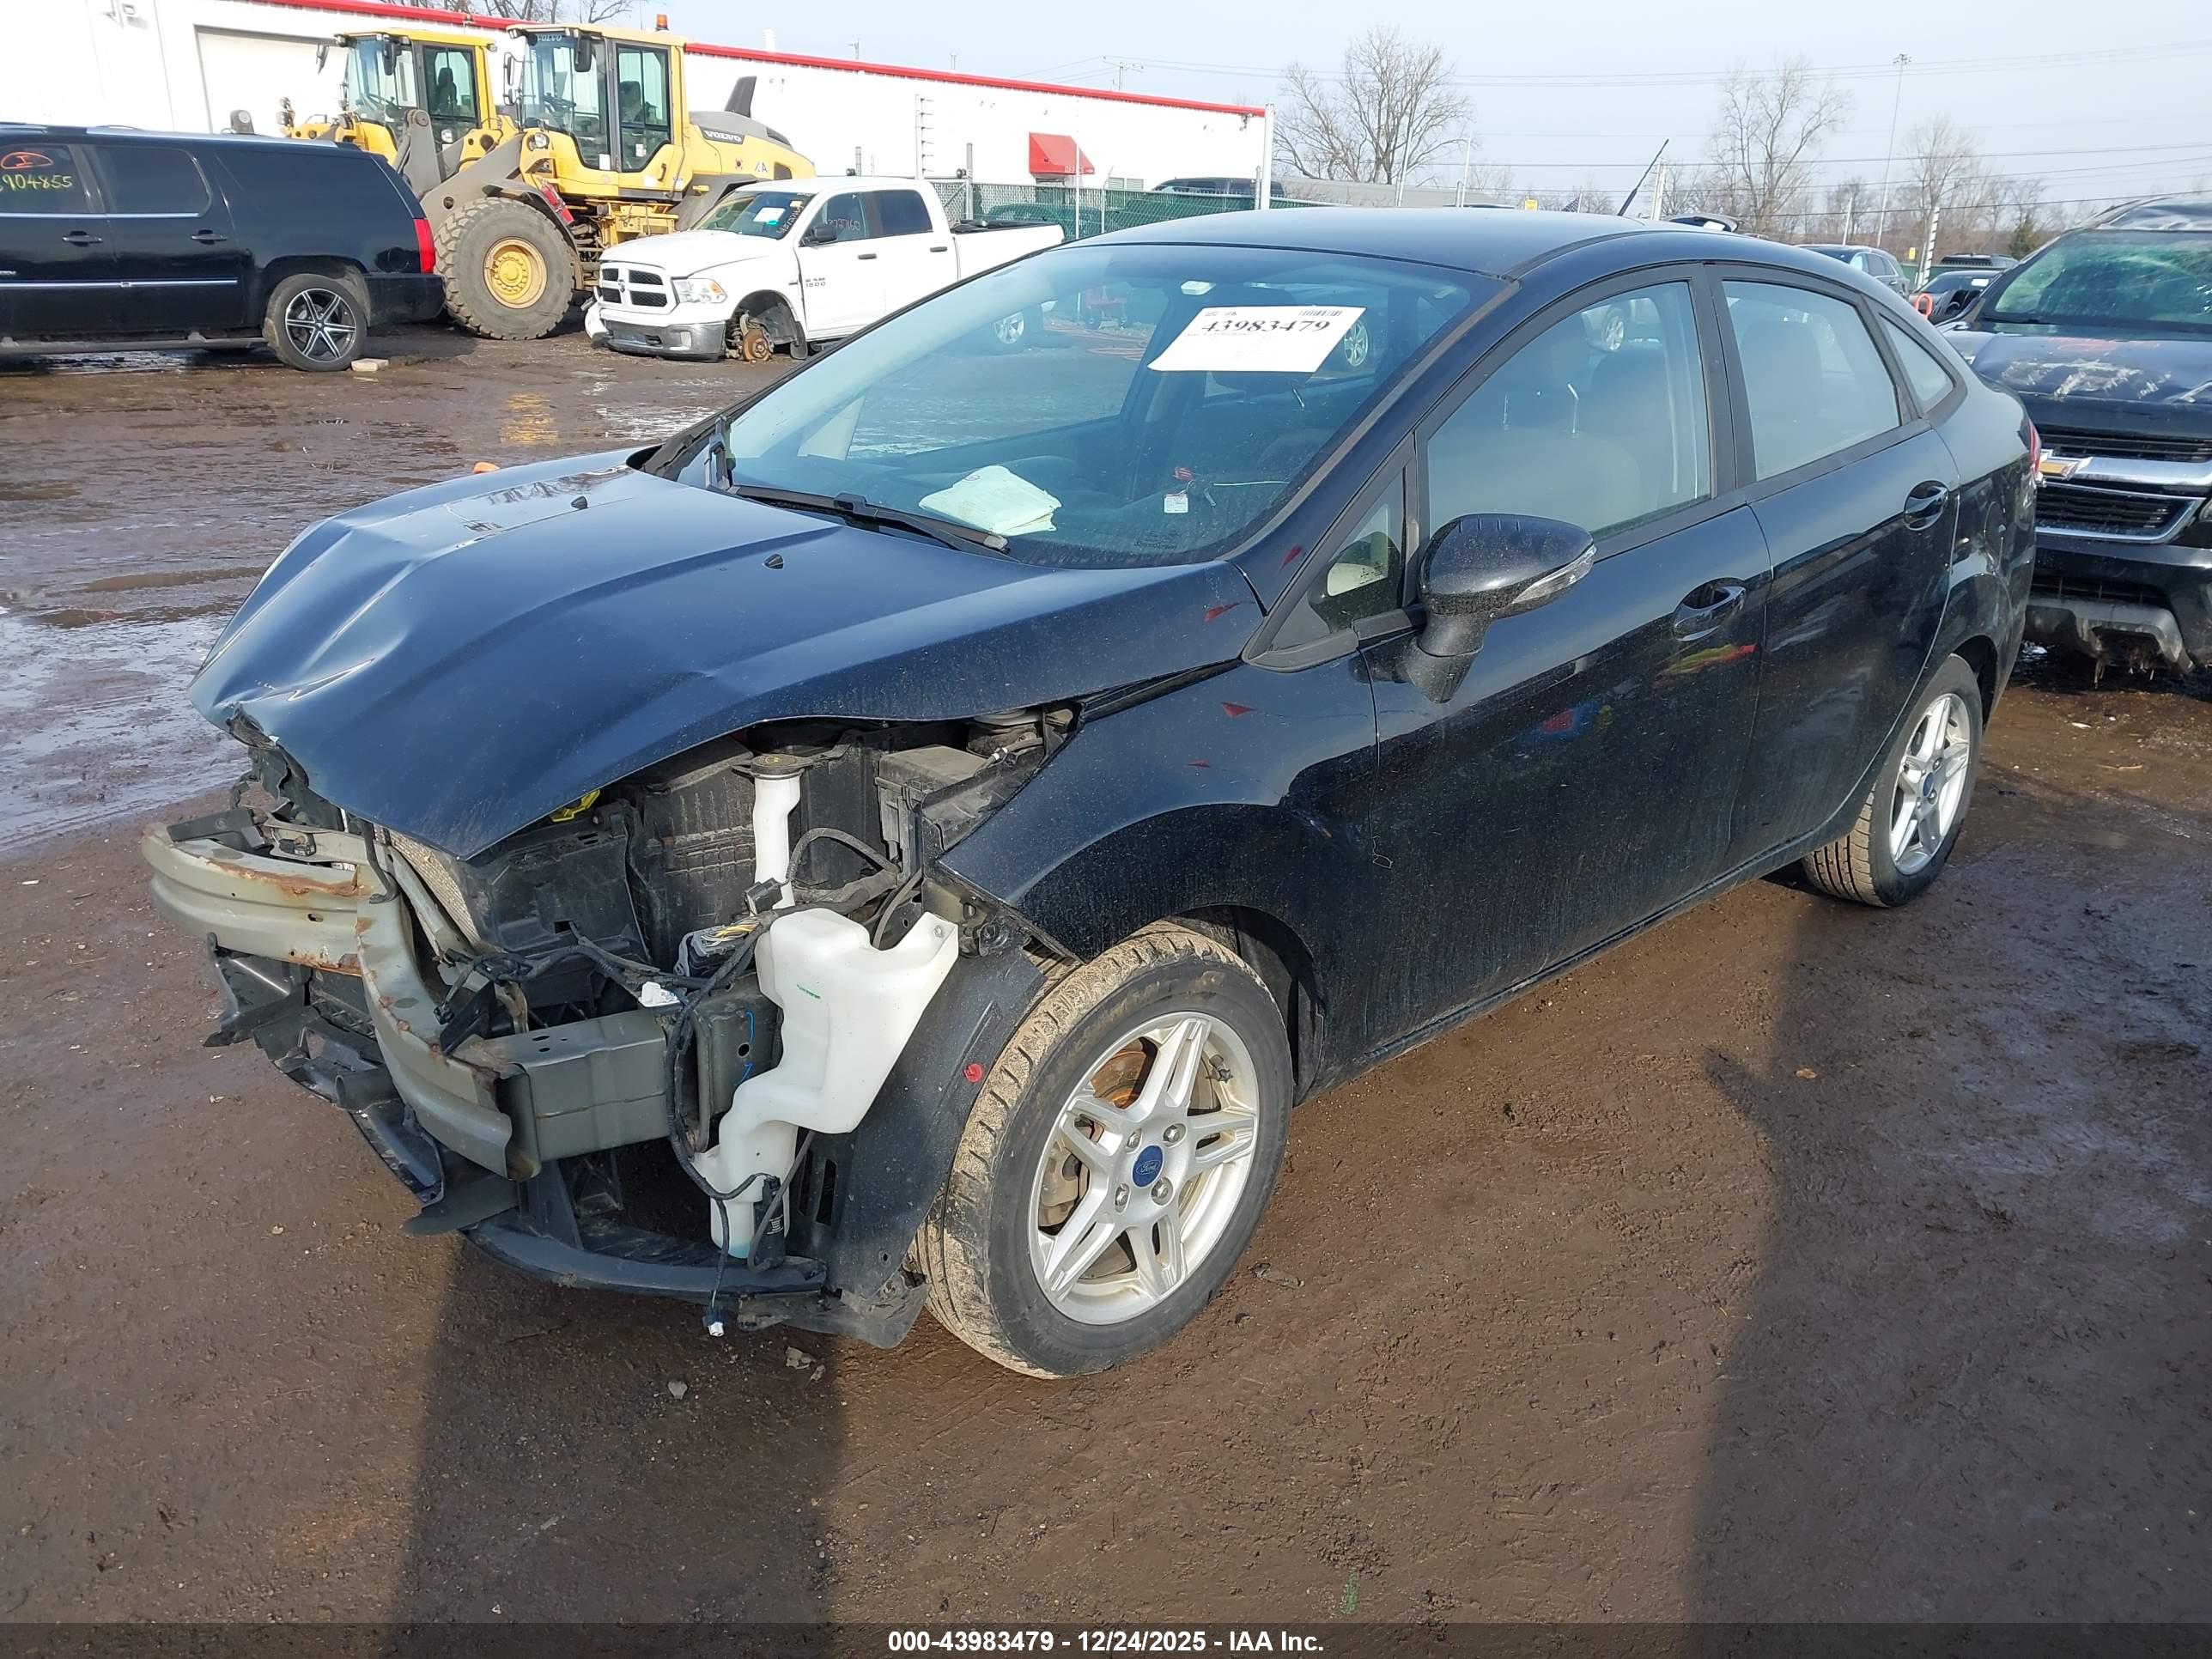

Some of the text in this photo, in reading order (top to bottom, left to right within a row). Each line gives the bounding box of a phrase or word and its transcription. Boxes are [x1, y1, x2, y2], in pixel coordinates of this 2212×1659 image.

[537, 33, 562, 42] VOLVO
[703, 130, 743, 143] VOLVO
[1201, 319, 1331, 333] 43983479
